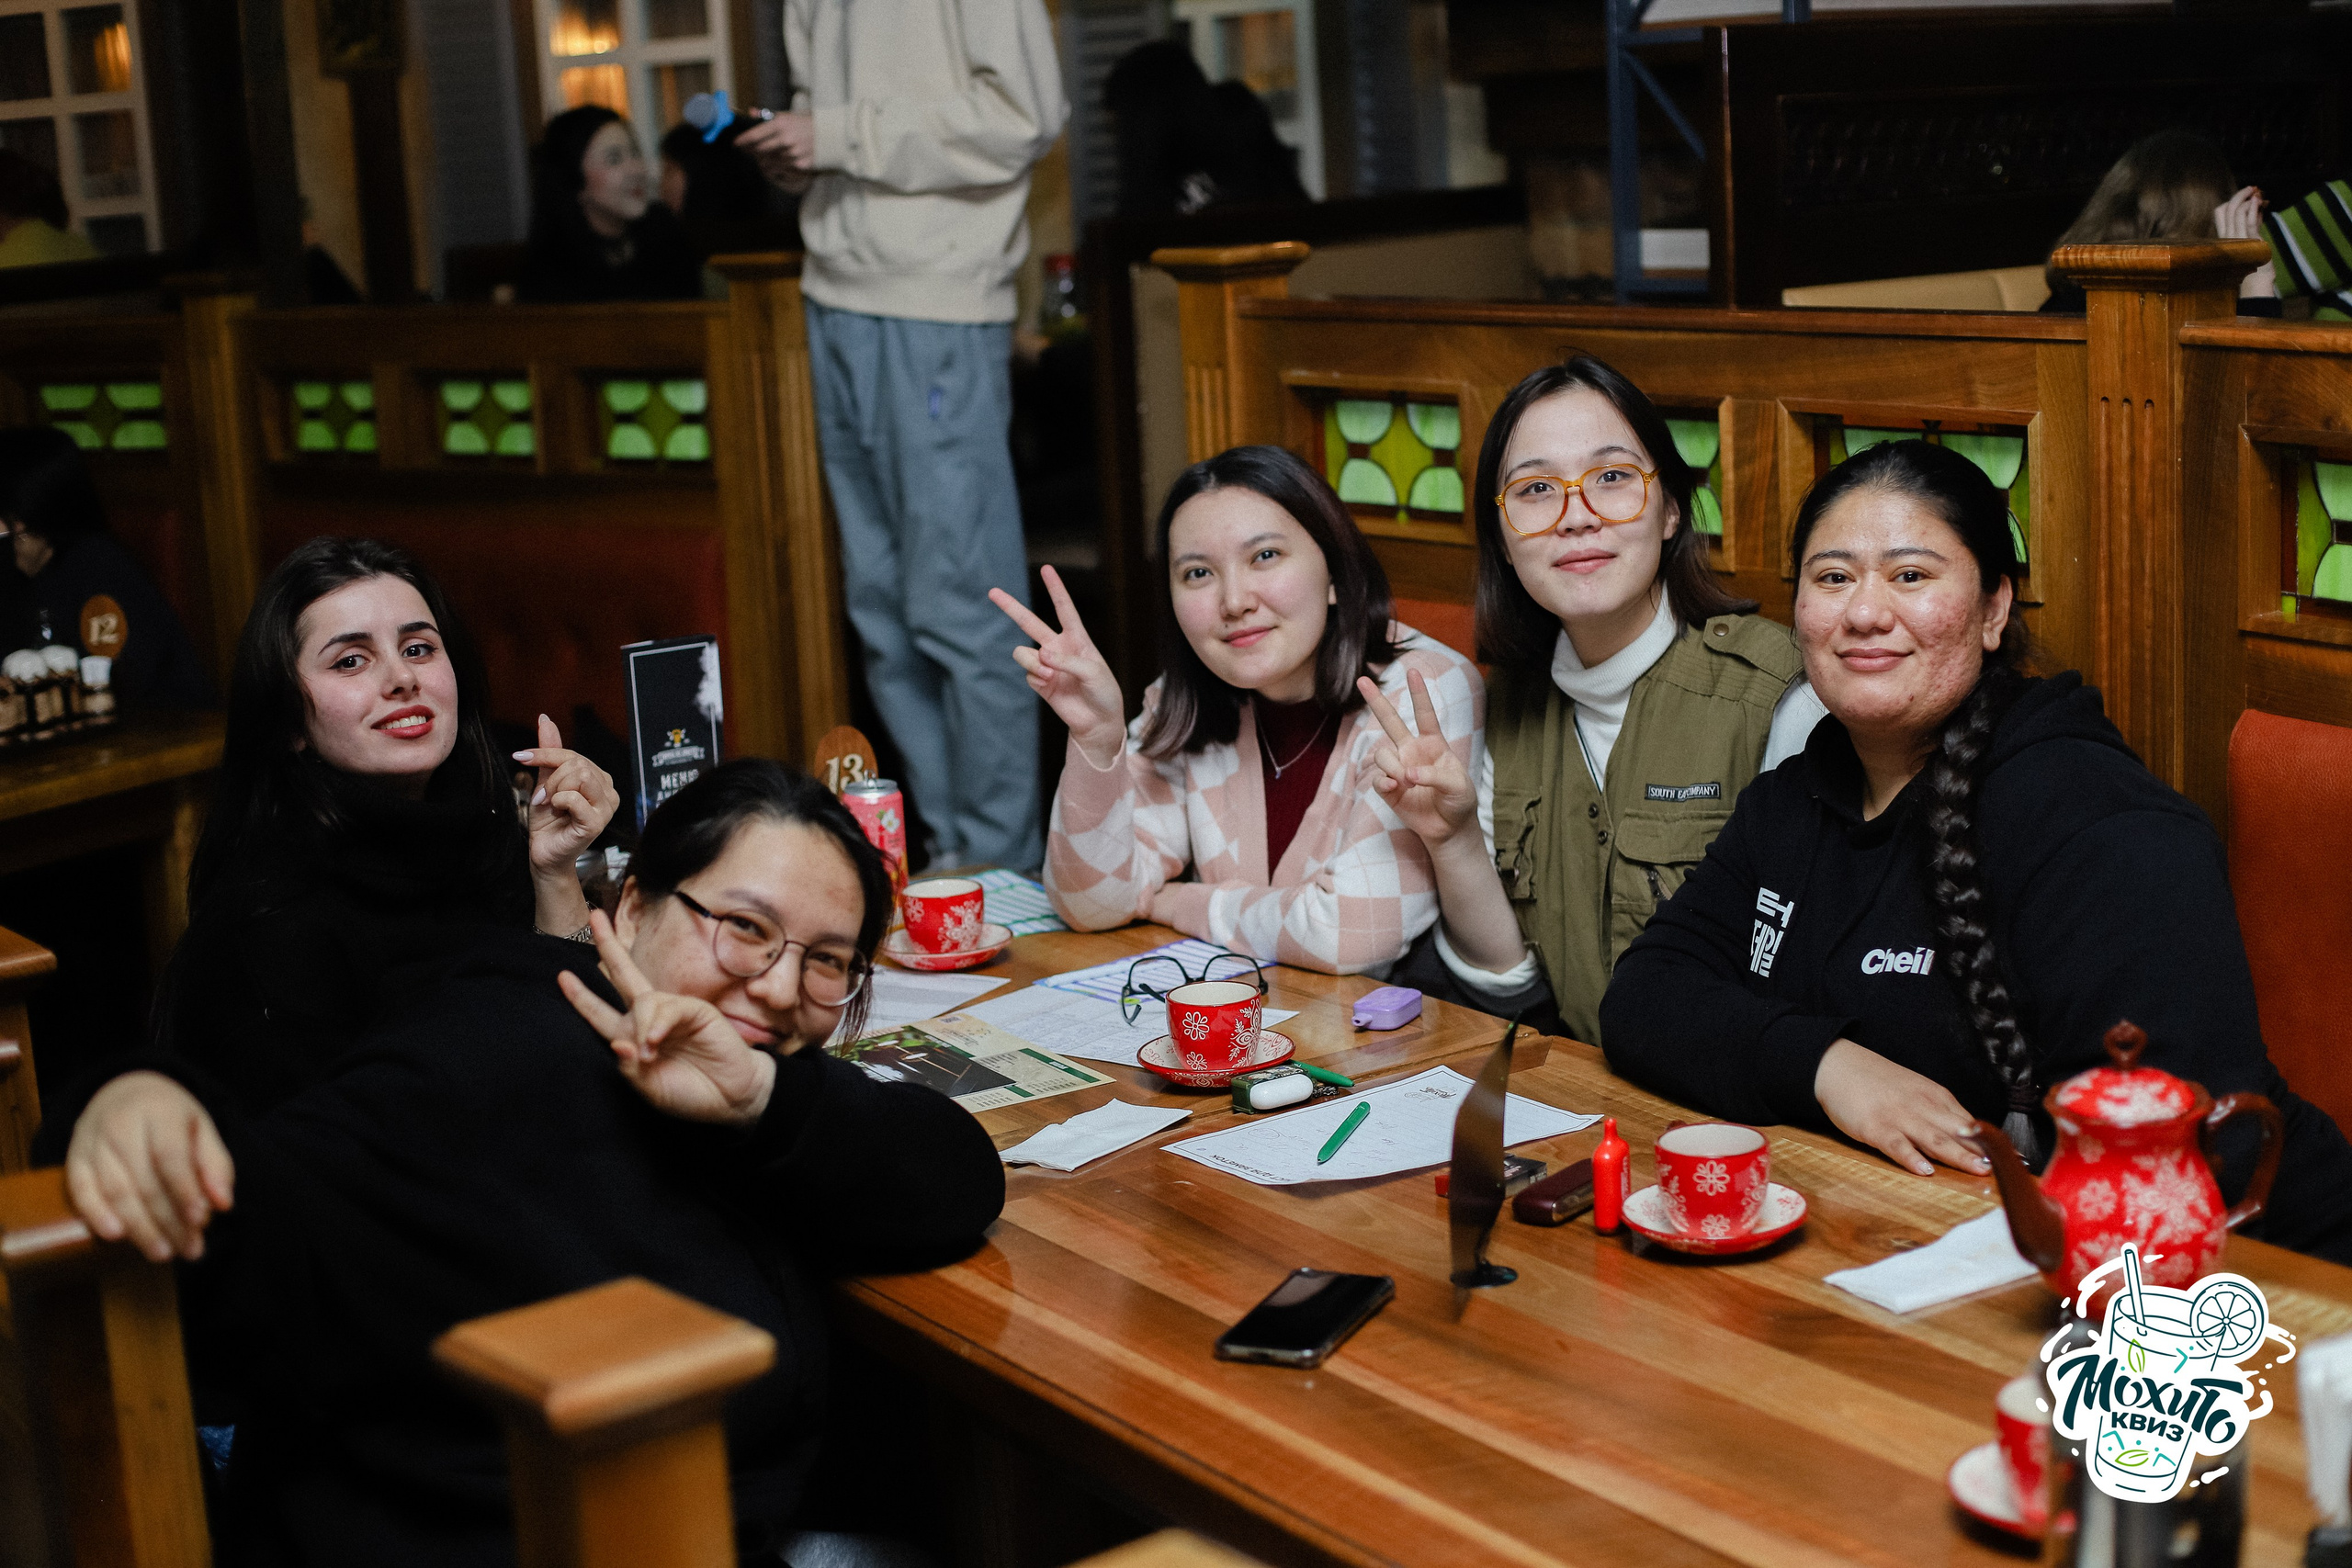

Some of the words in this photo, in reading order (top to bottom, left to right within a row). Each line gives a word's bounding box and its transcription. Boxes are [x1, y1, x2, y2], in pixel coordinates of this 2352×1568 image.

[89, 613, 119, 646] 12
[826, 753, 865, 795] 13
[1650, 786, 1675, 799] SOUTH
[1861, 947, 1936, 976] Cheil
